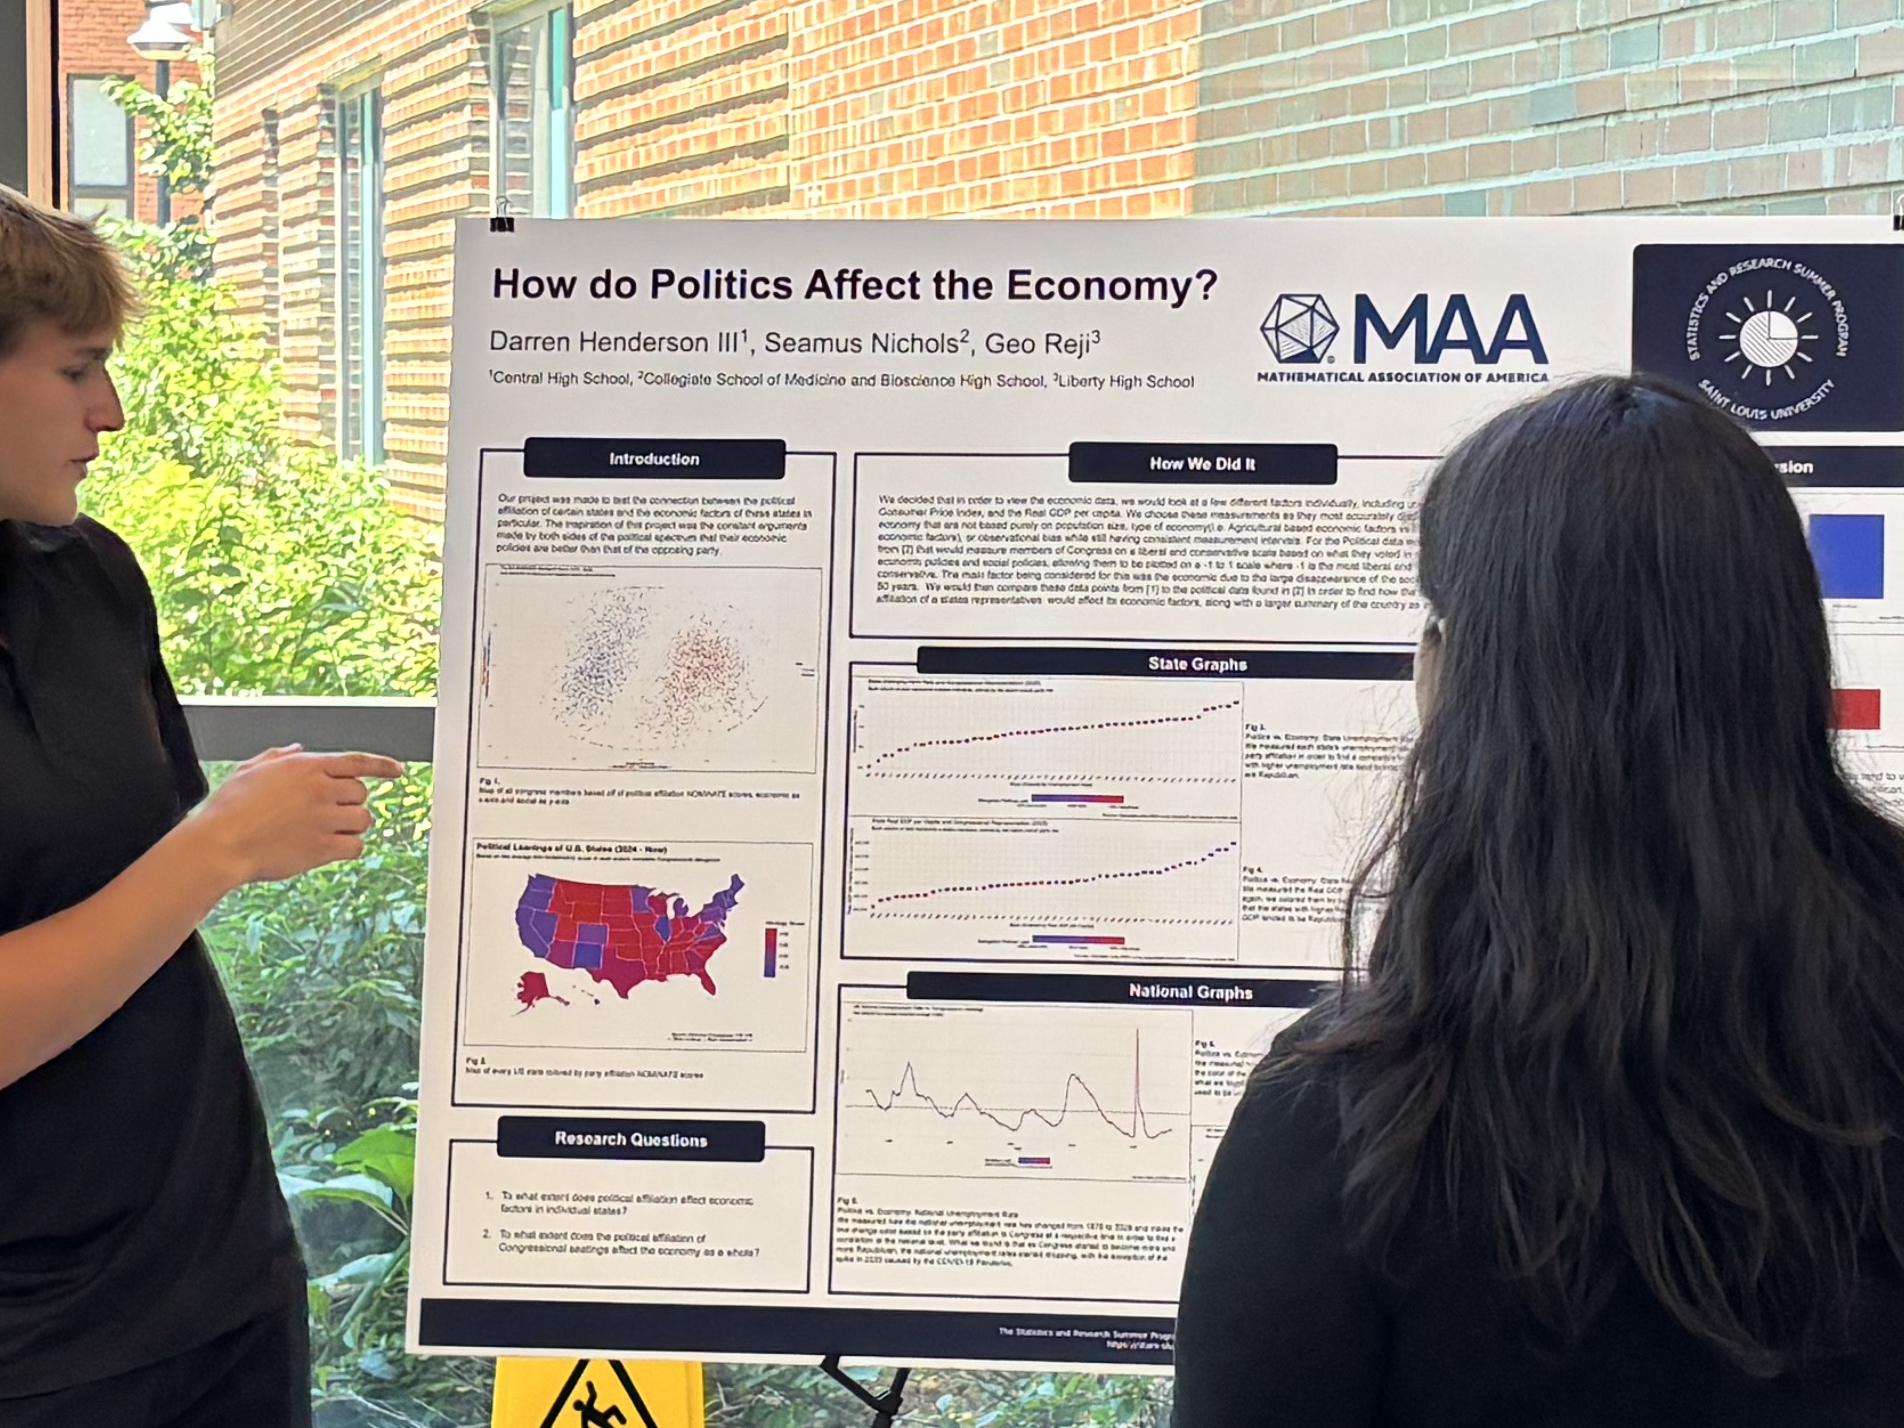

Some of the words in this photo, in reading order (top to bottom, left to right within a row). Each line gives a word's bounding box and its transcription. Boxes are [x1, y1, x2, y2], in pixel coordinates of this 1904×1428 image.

[493, 267, 577, 298] How
[589, 268, 636, 298] do
[650, 268, 792, 299] Politics
[804, 268, 920, 300] Affect
[932, 268, 993, 300] the
[1007, 268, 1217, 308] Economy?
[1686, 292, 1709, 361] STATISTICS
[1706, 272, 1729, 295] AND
[1728, 257, 1792, 277] RESEARCH
[1793, 263, 1838, 300] SUMMER
[1353, 293, 1549, 364] MAA
[490, 330, 570, 351] Darren
[579, 330, 708, 352] Henderson
[764, 331, 862, 353] Seamus
[985, 332, 1035, 353] Geo
[547, 371, 578, 387] High
[582, 371, 633, 386] School,
[716, 372, 763, 386] School
[766, 373, 781, 386] of
[784, 373, 846, 386] Medicine
[850, 374, 876, 386] and
[880, 373, 955, 387] Bioscience
[960, 374, 991, 389] High
[996, 373, 1047, 388] School,
[1109, 374, 1142, 390] High
[1146, 374, 1194, 388] School
[1256, 371, 1364, 382] MATHEMATICAL
[1367, 372, 1461, 382] ASSOCIATION
[1464, 372, 1482, 382] OF
[1485, 372, 1549, 382] AMERICA
[1698, 378, 1730, 408] SAINT
[1730, 403, 1768, 421] LOUIS
[1770, 379, 1835, 421] UNIVERSITY
[609, 452, 699, 465] Introduction
[1149, 456, 1184, 470] How
[1187, 456, 1211, 470] We
[1215, 456, 1241, 470] Did
[1245, 457, 1255, 470] It
[1148, 656, 1188, 670] State
[1191, 657, 1247, 673] Graphs
[1129, 983, 1193, 998] National
[1196, 985, 1253, 1002] Graphs
[554, 1130, 626, 1146] Research
[630, 1132, 708, 1147] Questions
